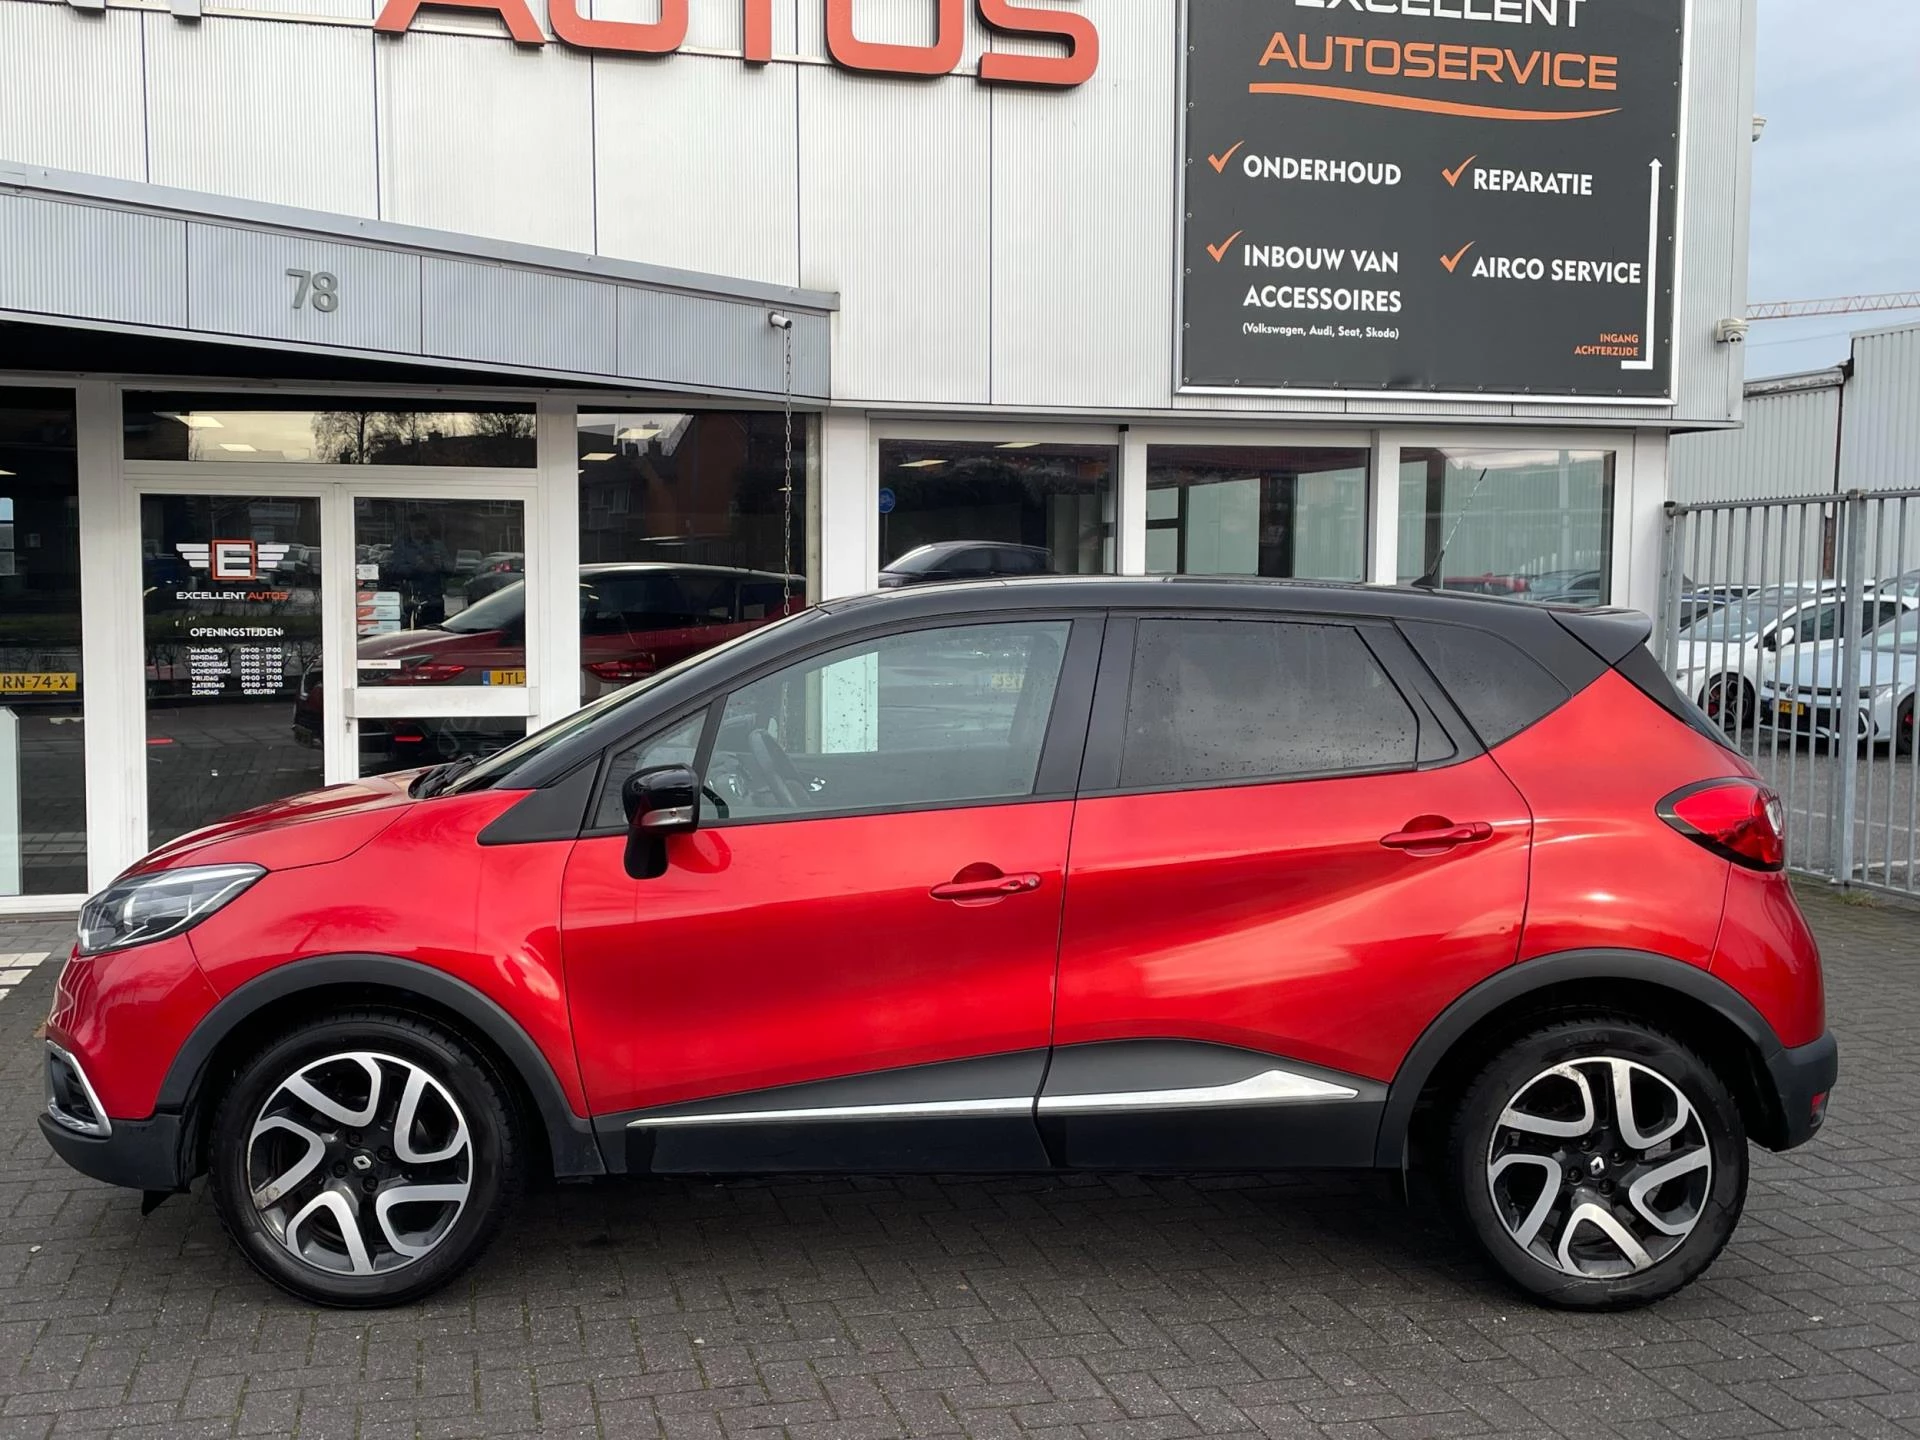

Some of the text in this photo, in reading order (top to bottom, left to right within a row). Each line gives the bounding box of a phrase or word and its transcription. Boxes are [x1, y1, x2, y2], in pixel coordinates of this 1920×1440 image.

[1295, 0, 1586, 27] ELLENT
[1258, 32, 1618, 90] AUTOSERVICE
[1243, 154, 1402, 185] ONDERHOUD
[1473, 168, 1593, 196] REPARATIE
[1244, 244, 1399, 273] INBOUW VAN
[1471, 256, 1641, 284] AIRCO SERVICE
[286, 267, 339, 313] 78
[1242, 285, 1402, 313] ACCESSOIRES
[1242, 322, 1399, 339] (Volkswagen, Audi, Seat, Skoda)
[1600, 333, 1639, 344] INGANG
[1574, 345, 1639, 357] ACHTERZIJDE
[176, 591, 289, 600] EXCELLENT AUTOS
[3, 676, 69, 688] RN-74-X
